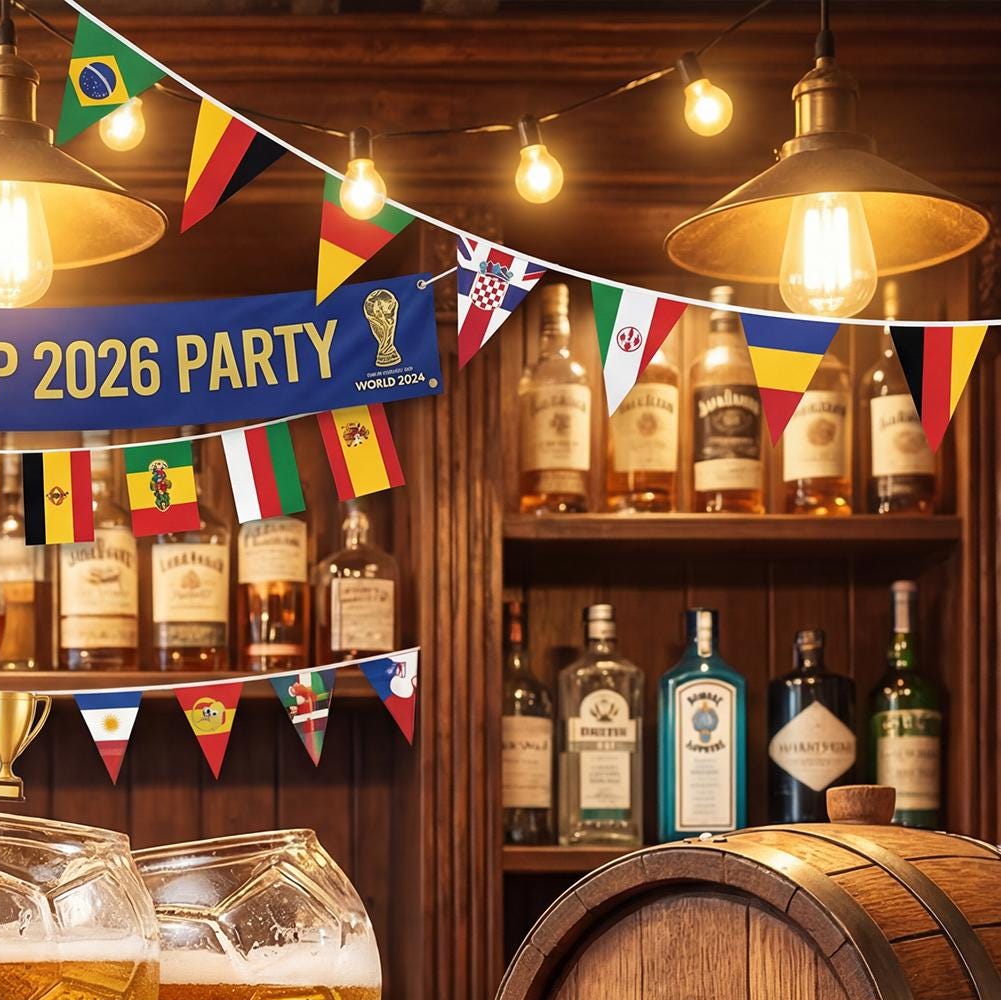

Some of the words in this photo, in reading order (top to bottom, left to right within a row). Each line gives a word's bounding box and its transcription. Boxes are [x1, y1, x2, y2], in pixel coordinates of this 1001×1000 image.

[33, 337, 161, 400] 2026
[176, 319, 338, 393] PARTY
[355, 377, 396, 391] WORLD
